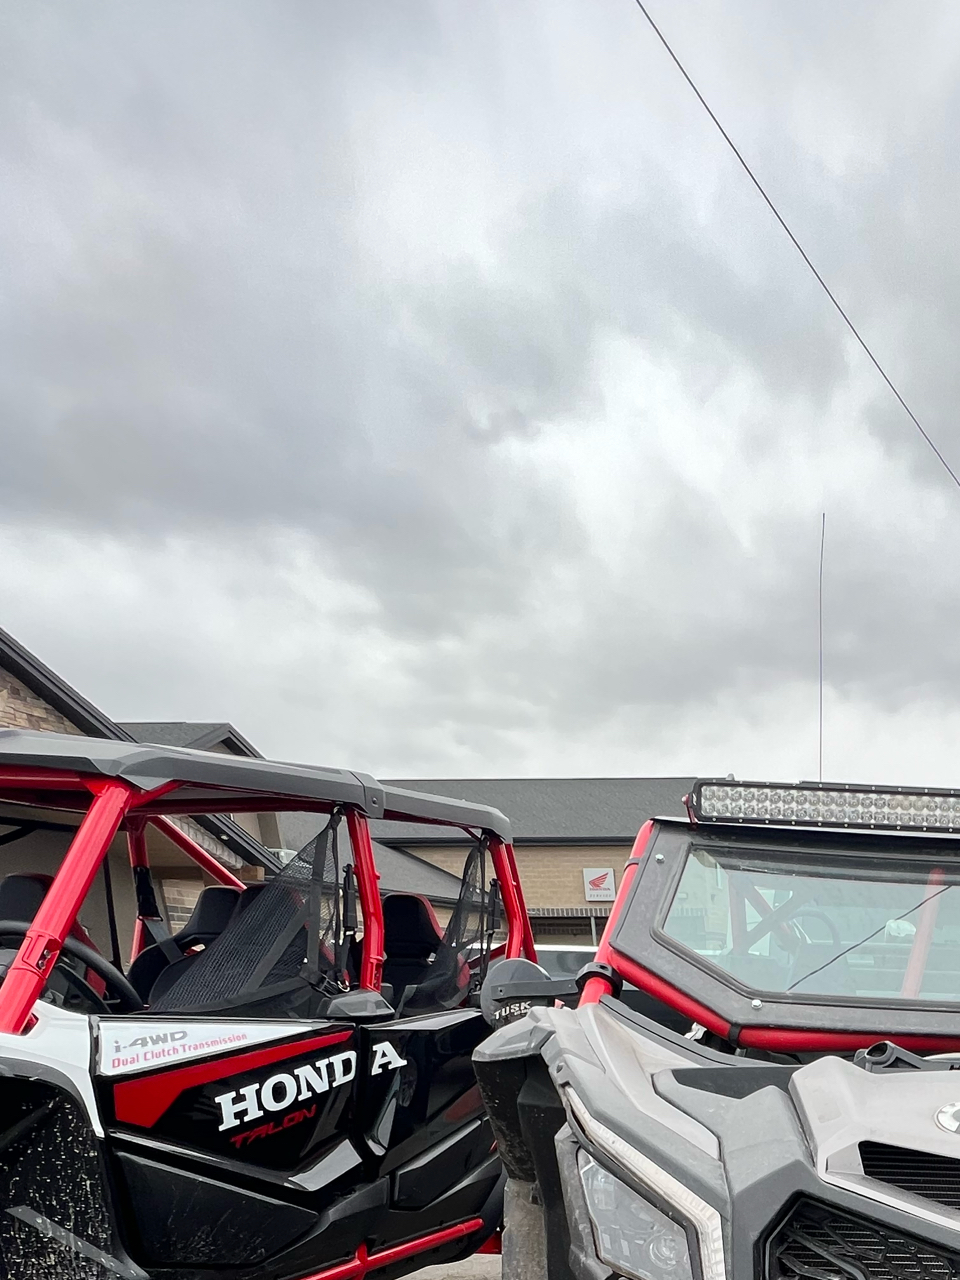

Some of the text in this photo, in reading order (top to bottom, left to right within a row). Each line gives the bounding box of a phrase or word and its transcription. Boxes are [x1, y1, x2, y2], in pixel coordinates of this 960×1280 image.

[494, 1000, 532, 1020] TUSK
[112, 1032, 247, 1069] Dual Clutch Transmission
[113, 1030, 189, 1053] i-4WD
[214, 1041, 408, 1132] HONDA
[230, 1104, 317, 1149] TALON
